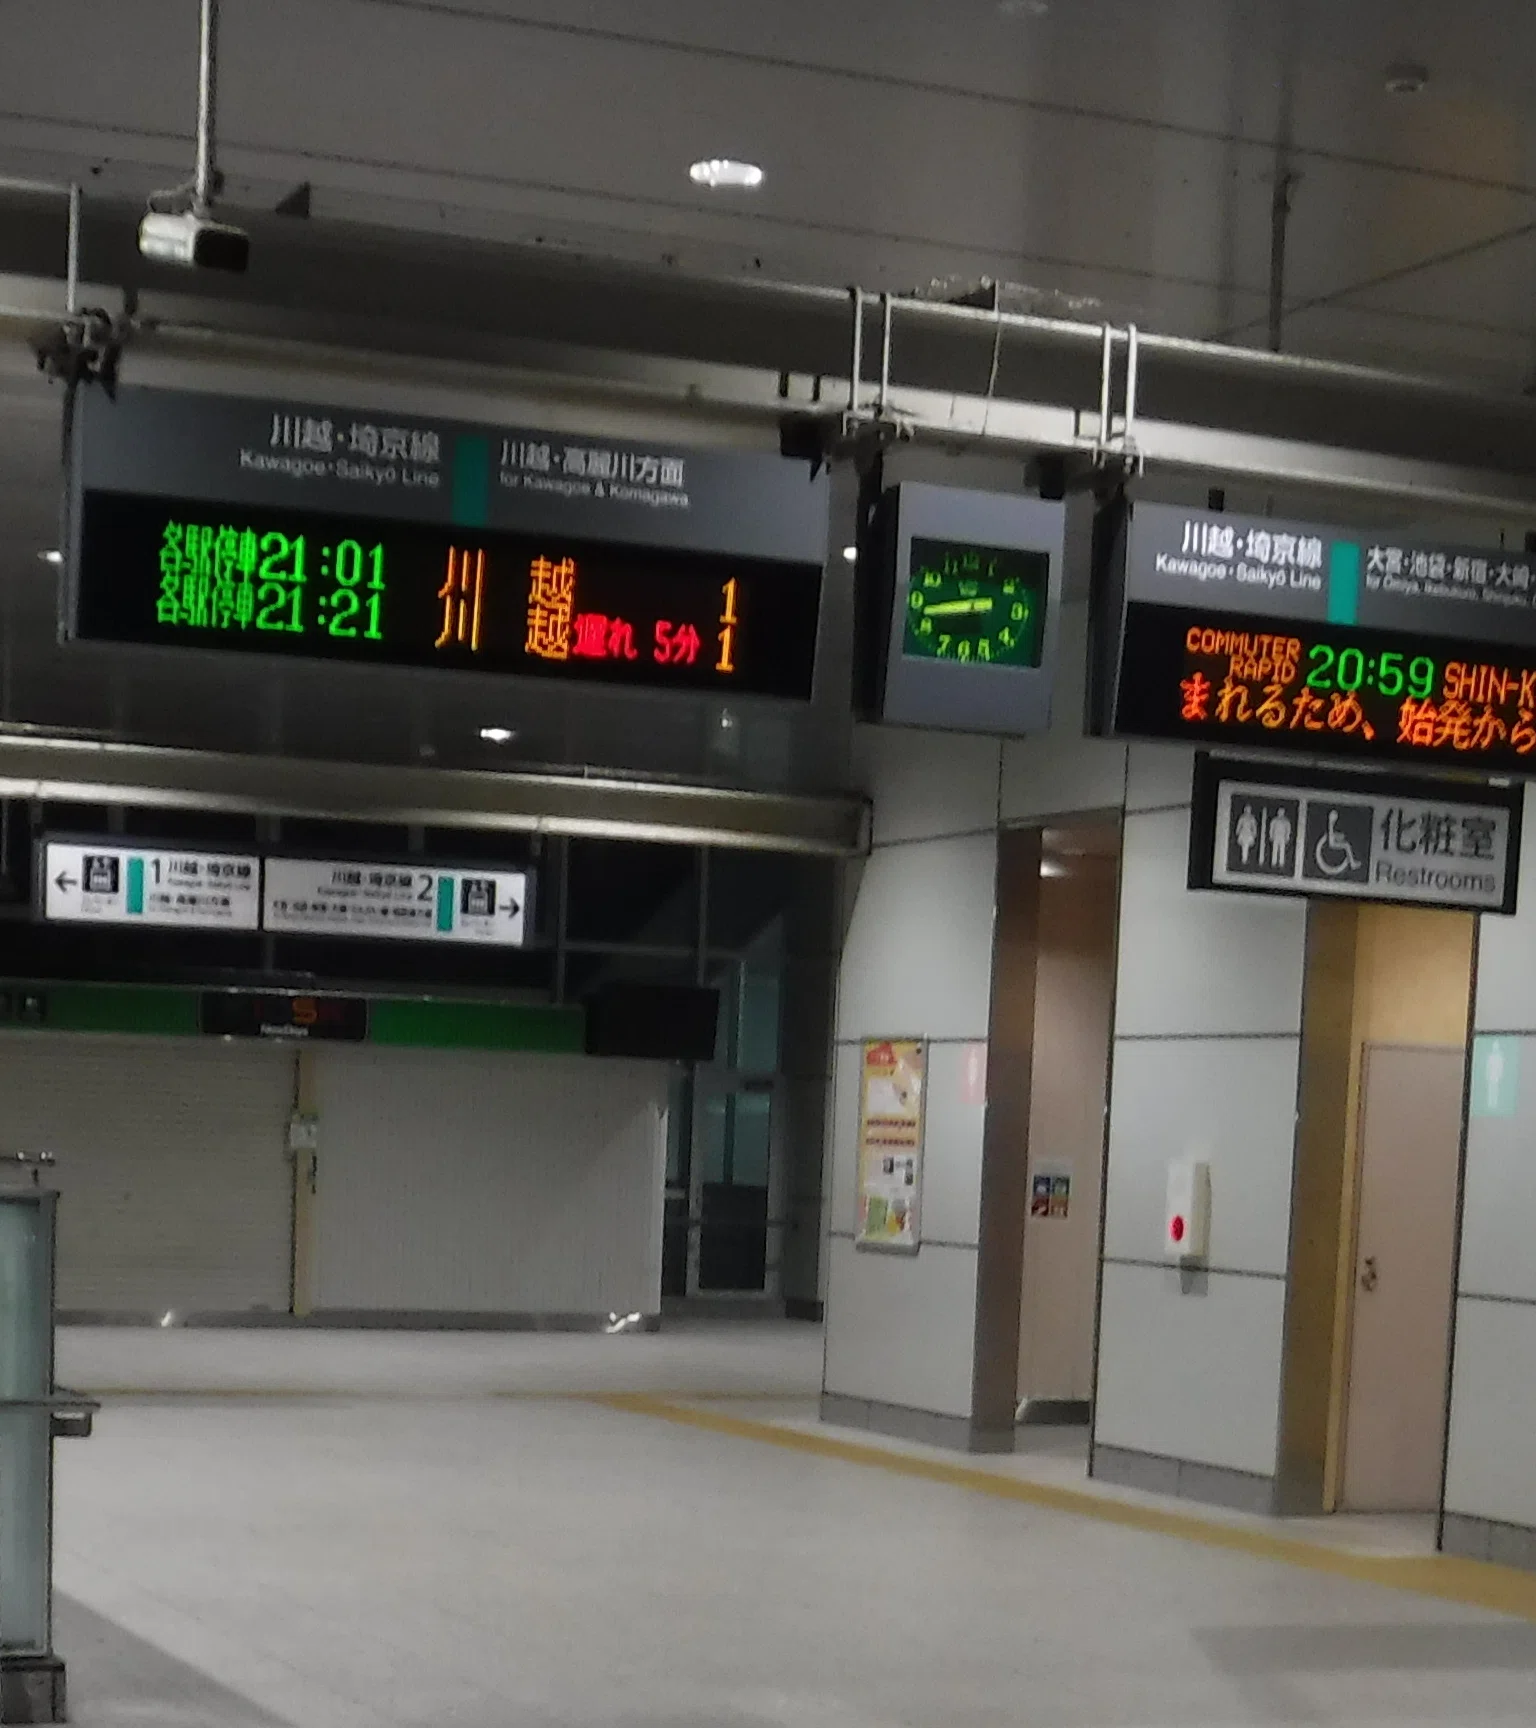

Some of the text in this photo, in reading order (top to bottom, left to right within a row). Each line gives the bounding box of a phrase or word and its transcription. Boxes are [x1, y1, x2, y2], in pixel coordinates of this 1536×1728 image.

[258, 531, 386, 591] 21:01
[1181, 519, 1323, 569] 川越・埼京線
[719, 576, 738, 626] 1
[1290, 568, 1323, 591] Line
[255, 581, 383, 640] 21:21
[715, 624, 736, 674] 1
[1185, 625, 1302, 664] COMMUTER
[1228, 652, 1297, 685] RAPID
[1306, 643, 1435, 700] 20:59
[1379, 806, 1497, 861] 化粧室
[416, 873, 434, 902] 2
